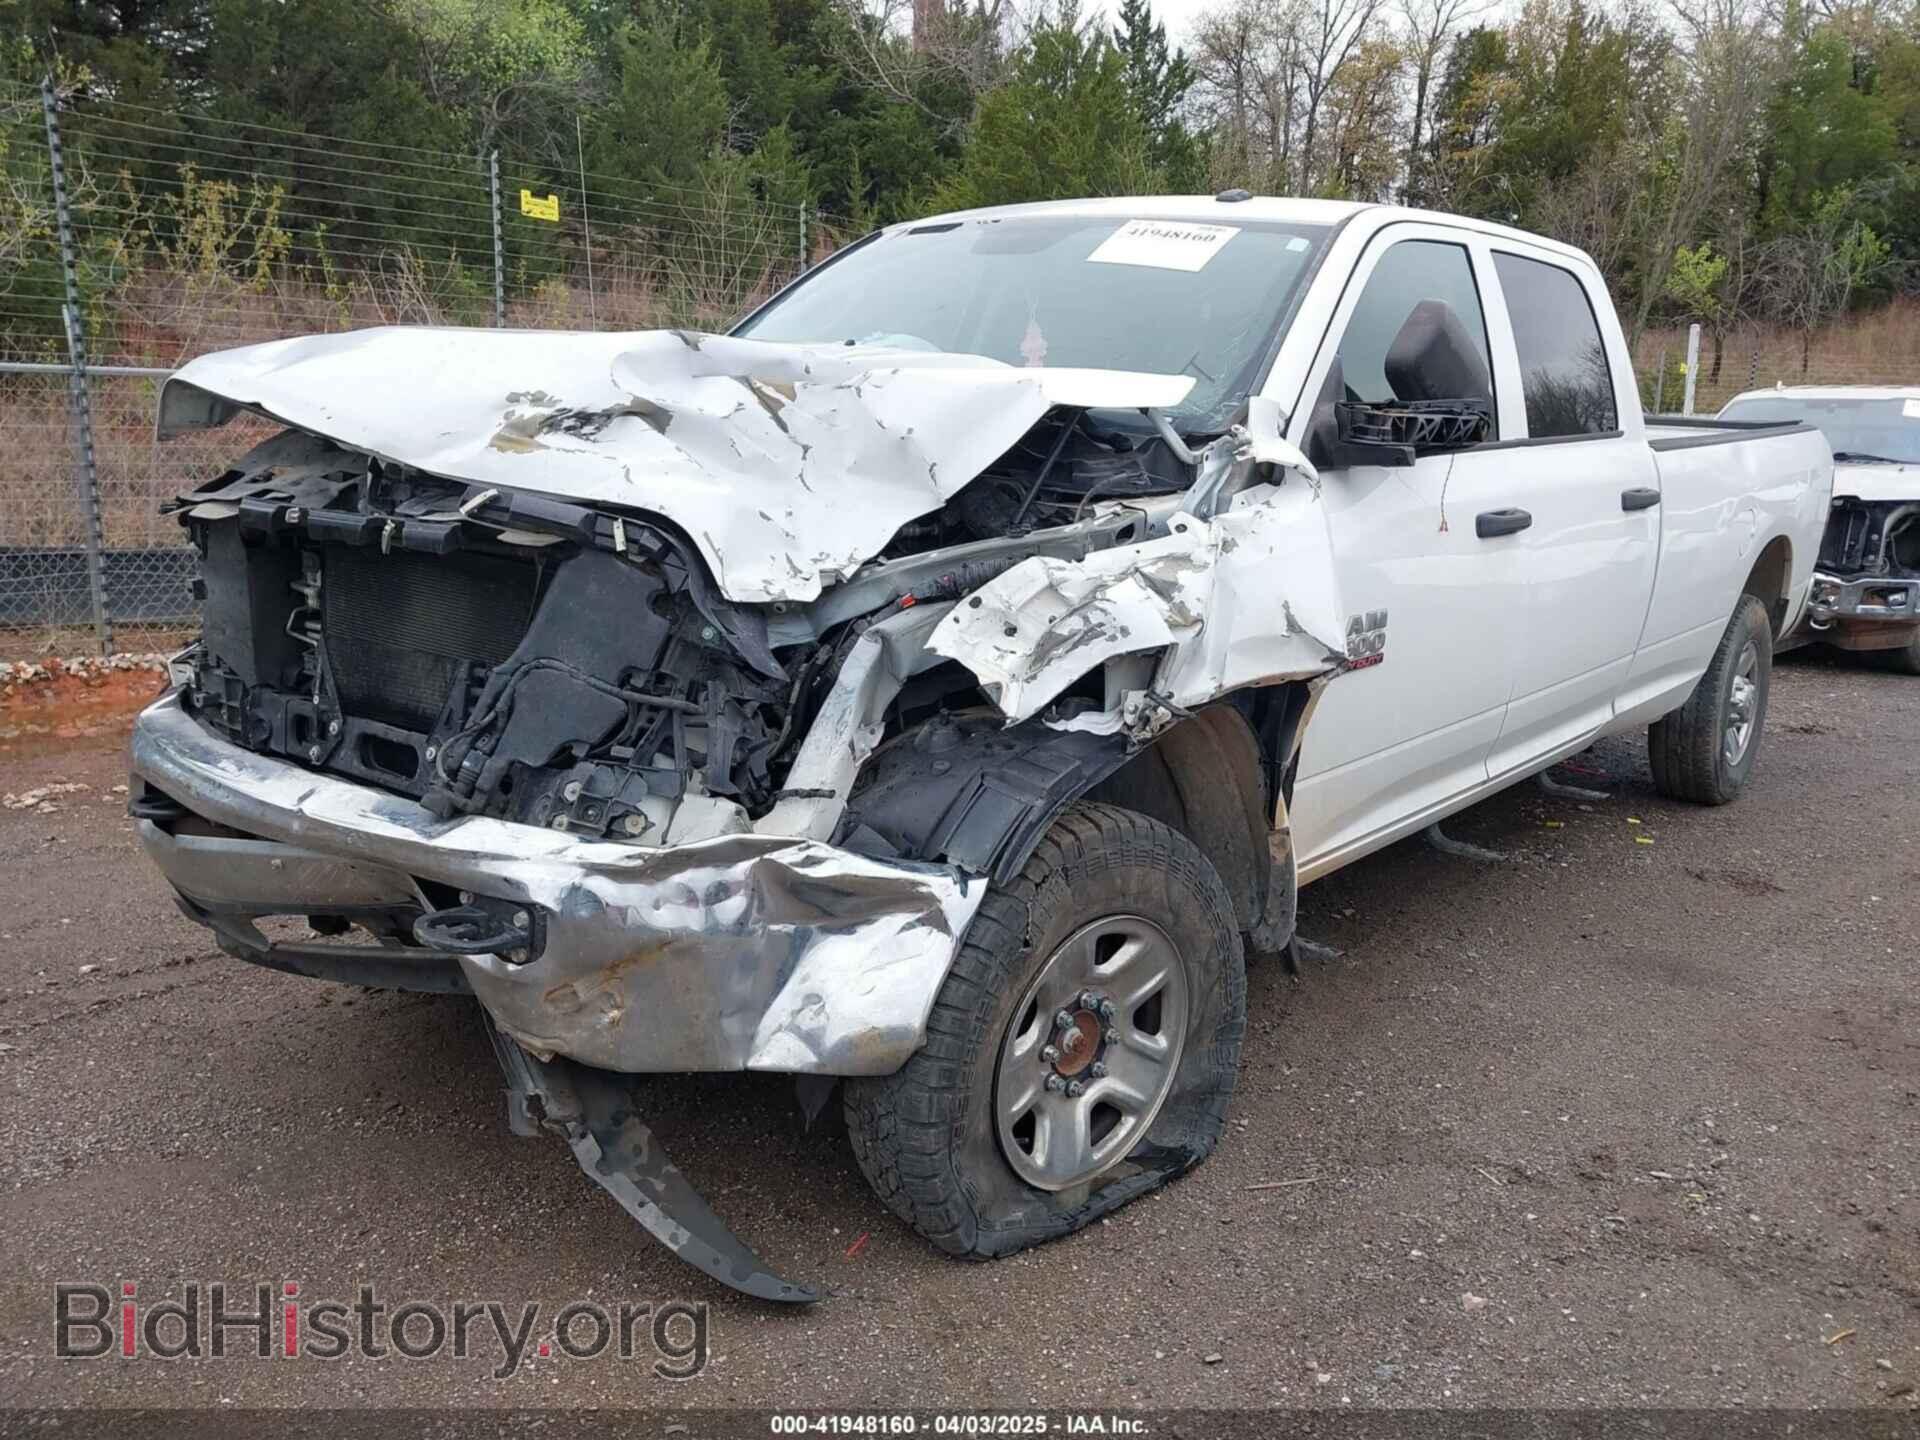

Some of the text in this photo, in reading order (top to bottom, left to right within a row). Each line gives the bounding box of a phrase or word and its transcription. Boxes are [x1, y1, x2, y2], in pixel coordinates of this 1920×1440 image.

[1128, 228, 1217, 243] 41948160
[1345, 608, 1388, 636] AM
[1346, 632, 1386, 658] 500
